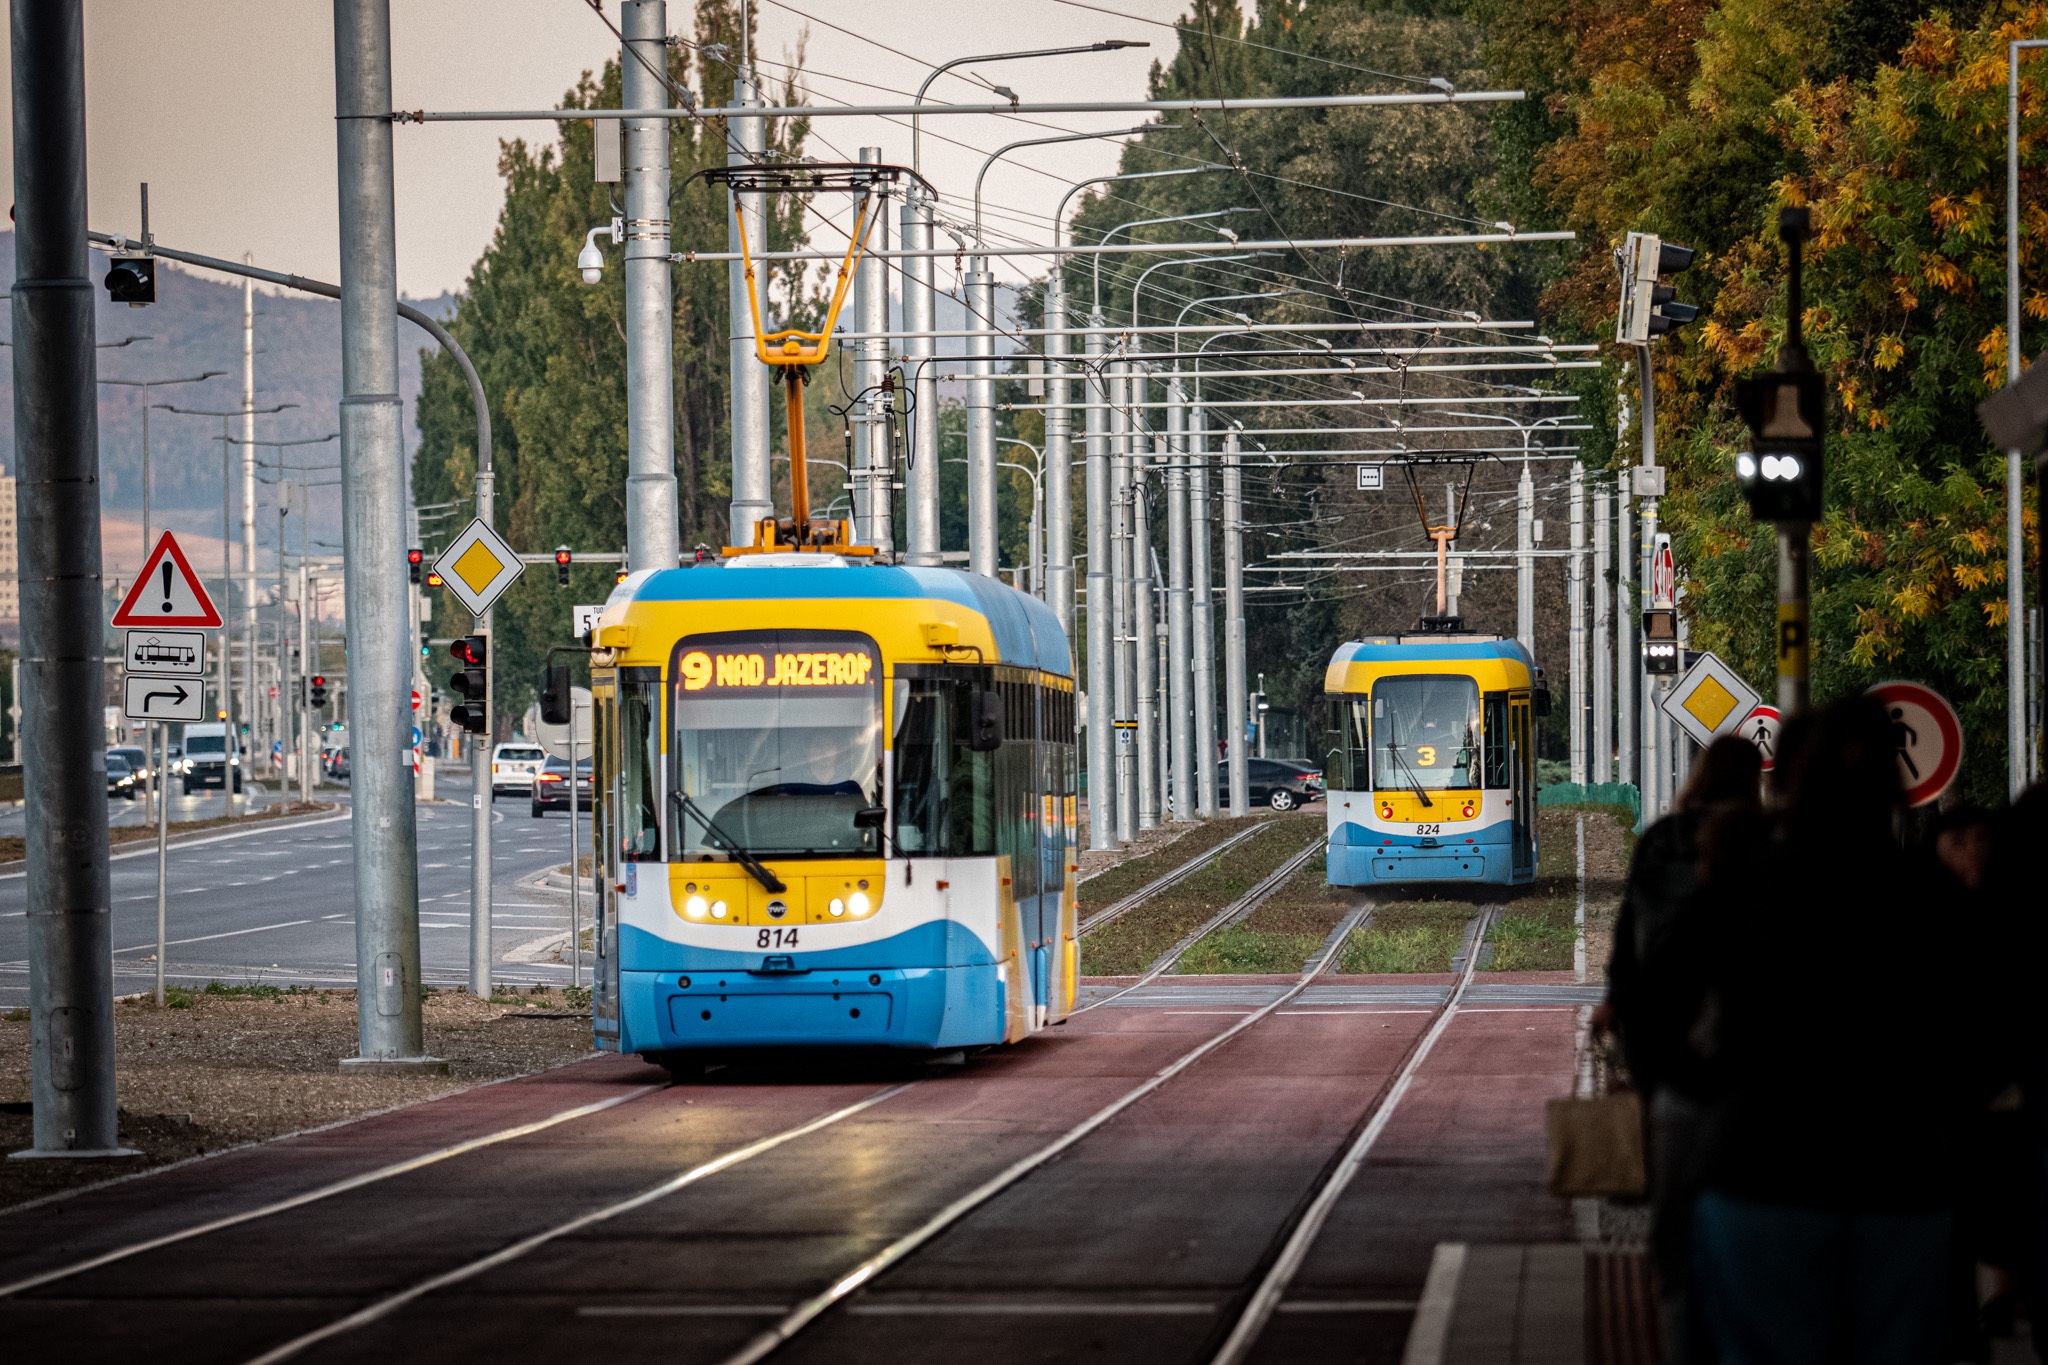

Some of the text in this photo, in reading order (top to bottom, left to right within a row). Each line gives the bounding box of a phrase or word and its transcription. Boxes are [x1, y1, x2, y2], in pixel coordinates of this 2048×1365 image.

[1782, 621, 1804, 659] P
[681, 651, 713, 690] 9
[716, 654, 765, 686] NAD
[1417, 746, 1436, 766] 3
[1416, 824, 1440, 835] 824
[757, 928, 799, 949] 814
